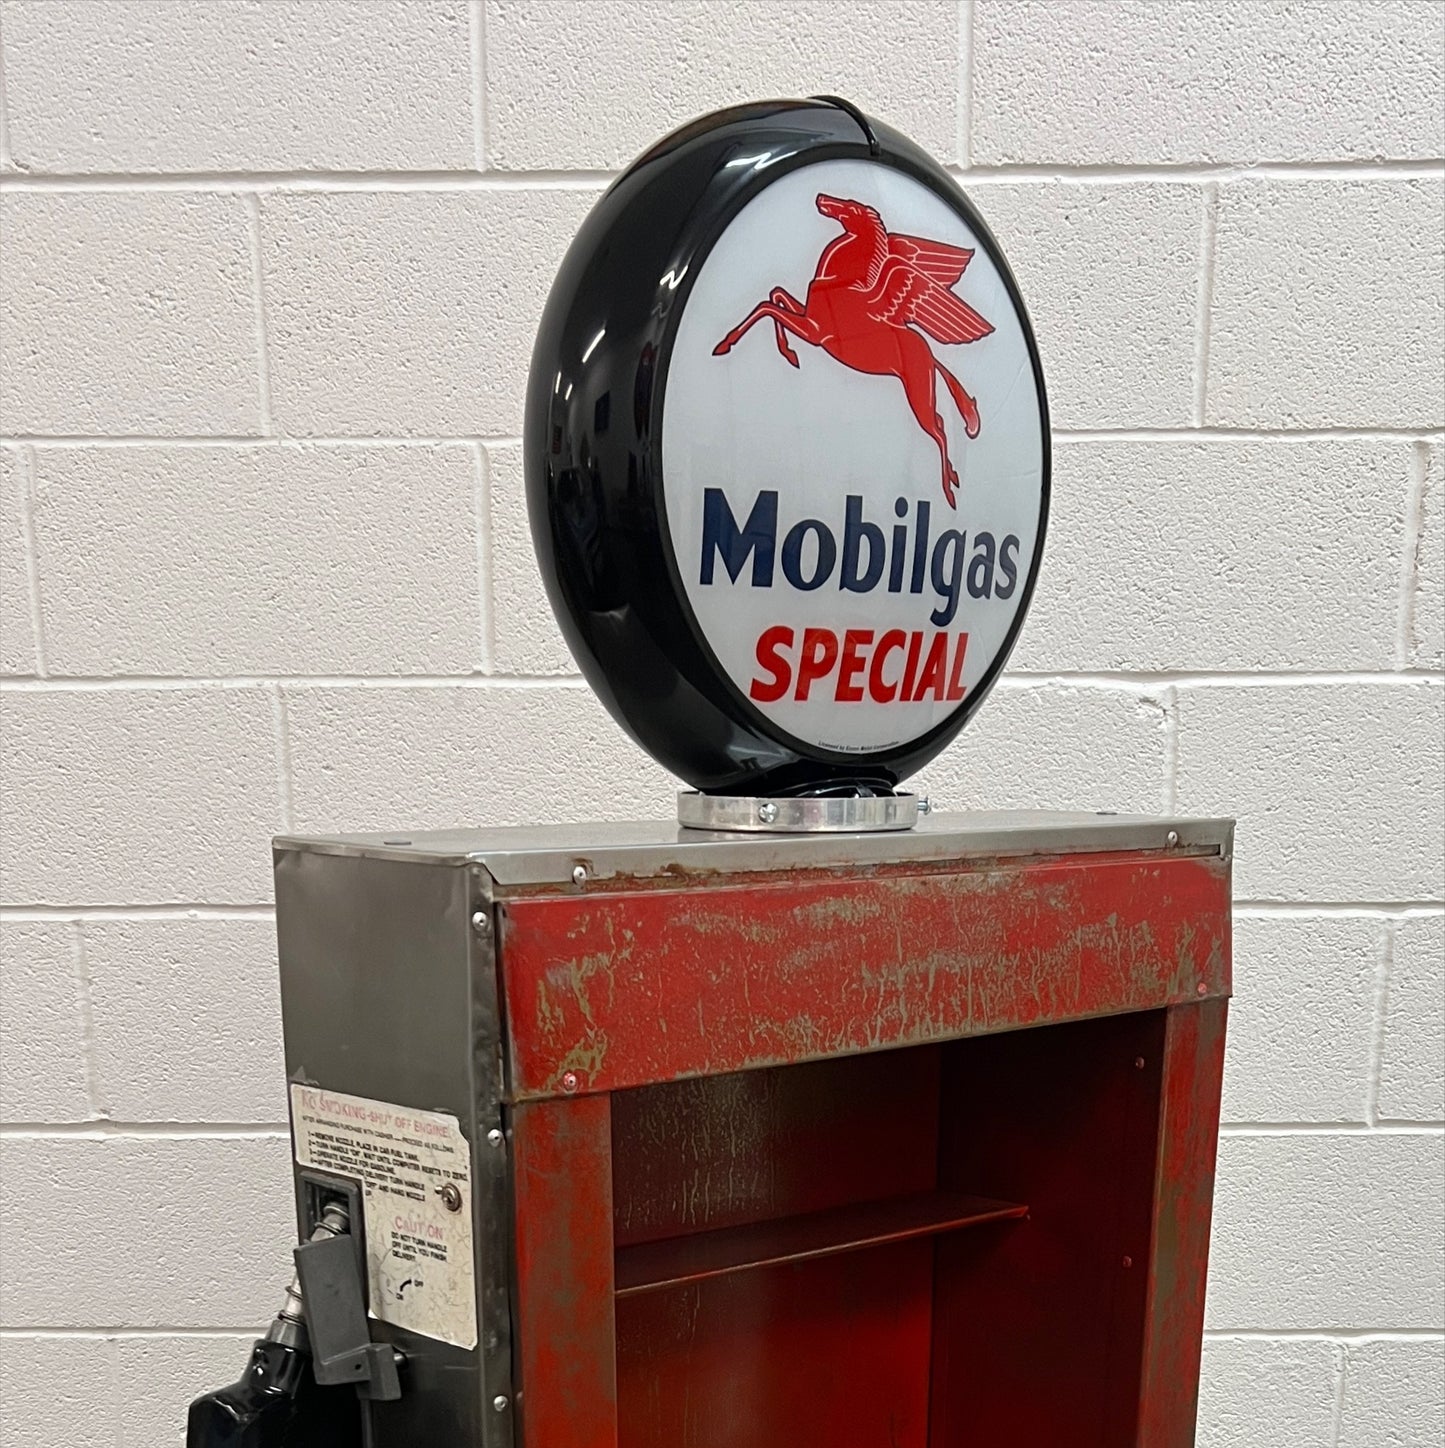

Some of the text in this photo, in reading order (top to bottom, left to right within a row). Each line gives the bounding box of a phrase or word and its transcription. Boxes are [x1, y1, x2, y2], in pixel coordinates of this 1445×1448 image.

[700, 488, 1020, 626] Mobilgas
[750, 626, 968, 702] SPECIAL
[395, 1216, 443, 1240] CAUTON
